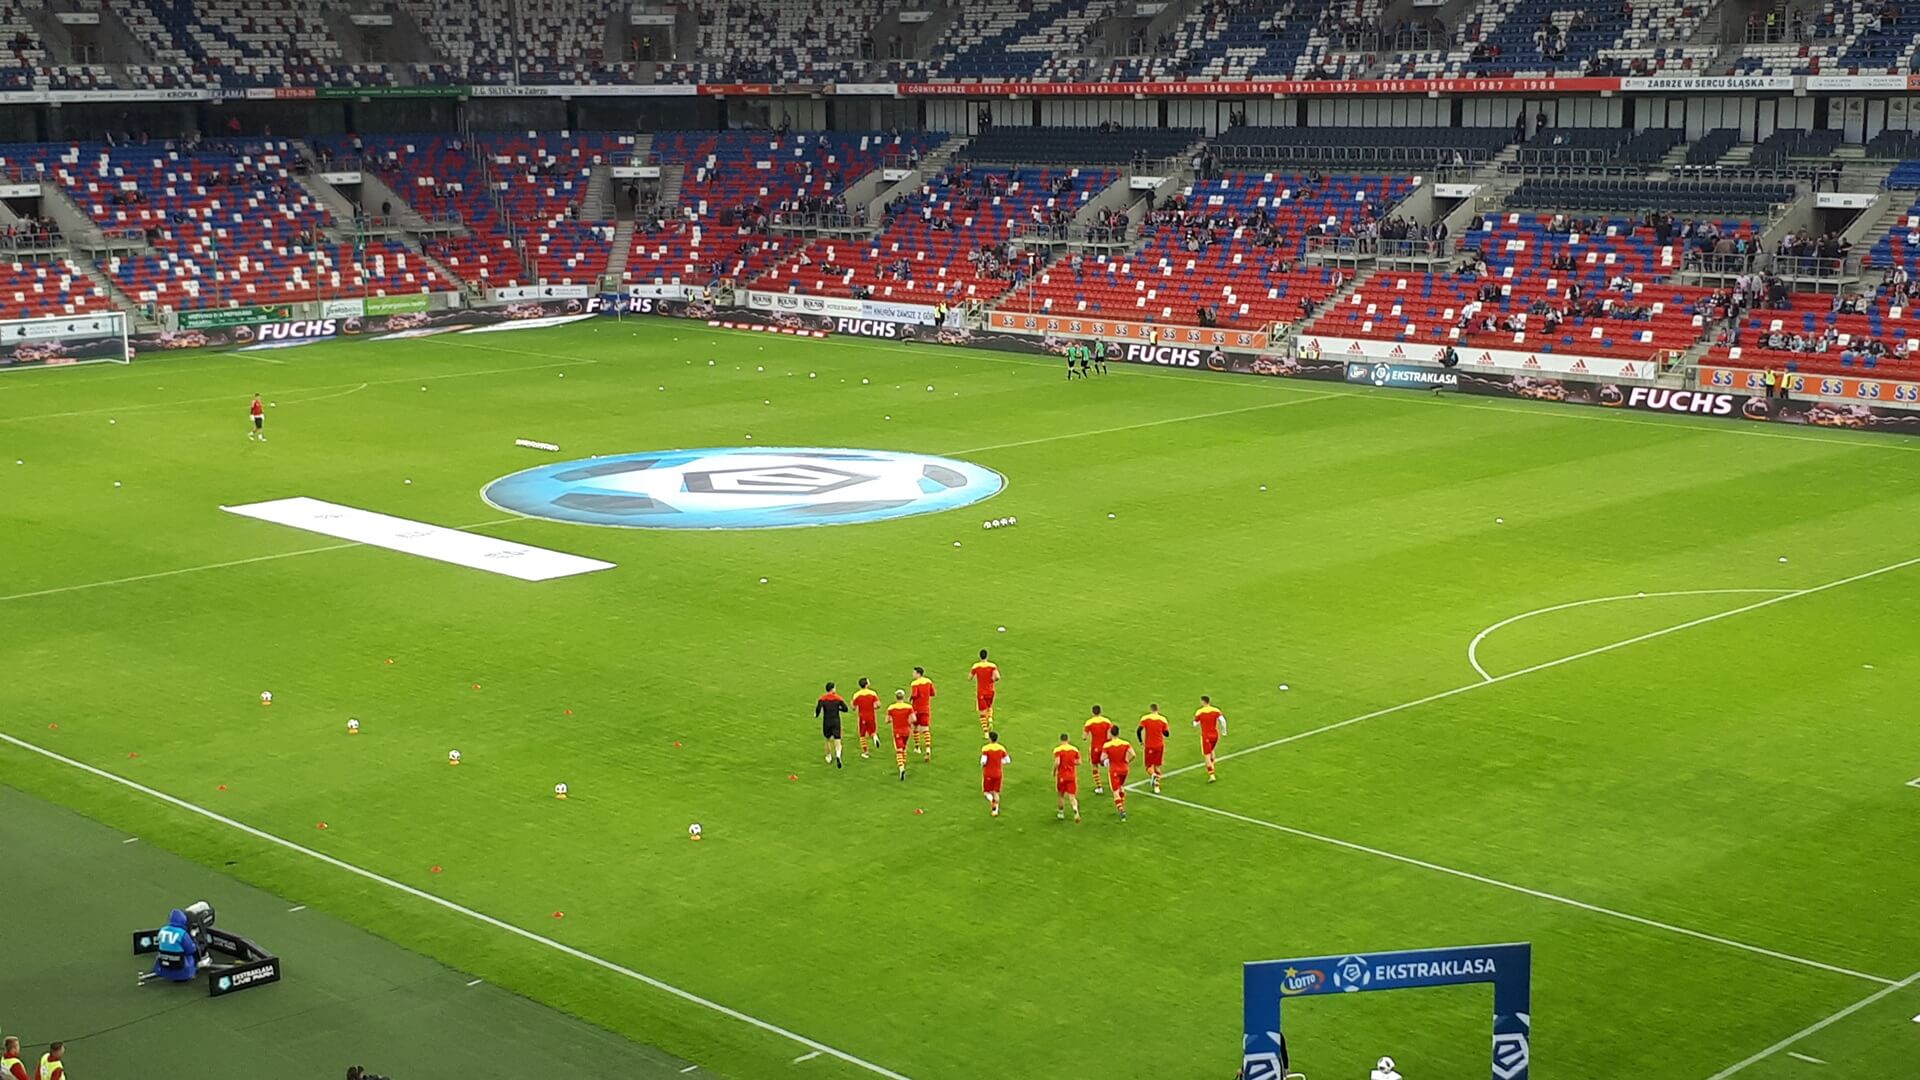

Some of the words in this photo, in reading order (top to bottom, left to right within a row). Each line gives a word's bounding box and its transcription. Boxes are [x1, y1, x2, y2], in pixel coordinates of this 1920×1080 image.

[908, 85, 935, 94] GÓRNIK
[937, 85, 966, 94] ZABRZE
[979, 85, 1001, 94] 1957
[1123, 85, 1149, 93] 1964
[1163, 85, 1188, 93] 1965
[1204, 84, 1230, 93] 1966
[1246, 84, 1273, 93] 1967
[1289, 83, 1315, 92] 1971
[1330, 83, 1358, 92] 1972
[1375, 82, 1405, 91] 1985
[1423, 82, 1454, 90] 1986
[1473, 81, 1504, 90] 1987
[1523, 80, 1555, 90] 1988
[1648, 79, 1682, 88] ZABRZE
[1684, 79, 1693, 88] W
[1695, 79, 1725, 88] SERCU
[1727, 77, 1764, 89] ŚLĄSKA
[585, 297, 652, 313] FHS
[896, 310, 916, 319] ZAWSZE
[258, 319, 337, 341] FUCHS
[838, 318, 896, 337] FUCHS
[1127, 344, 1200, 367] FUCHS
[1392, 370, 1458, 385] EKSTRAKLASA
[1628, 387, 1733, 415] FUCHS
[160, 930, 180, 945] TV
[232, 965, 274, 980] EKSTRAKLASA
[1375, 958, 1496, 980] EKSTRAKLASA
[1288, 974, 1316, 990] LOTTO
